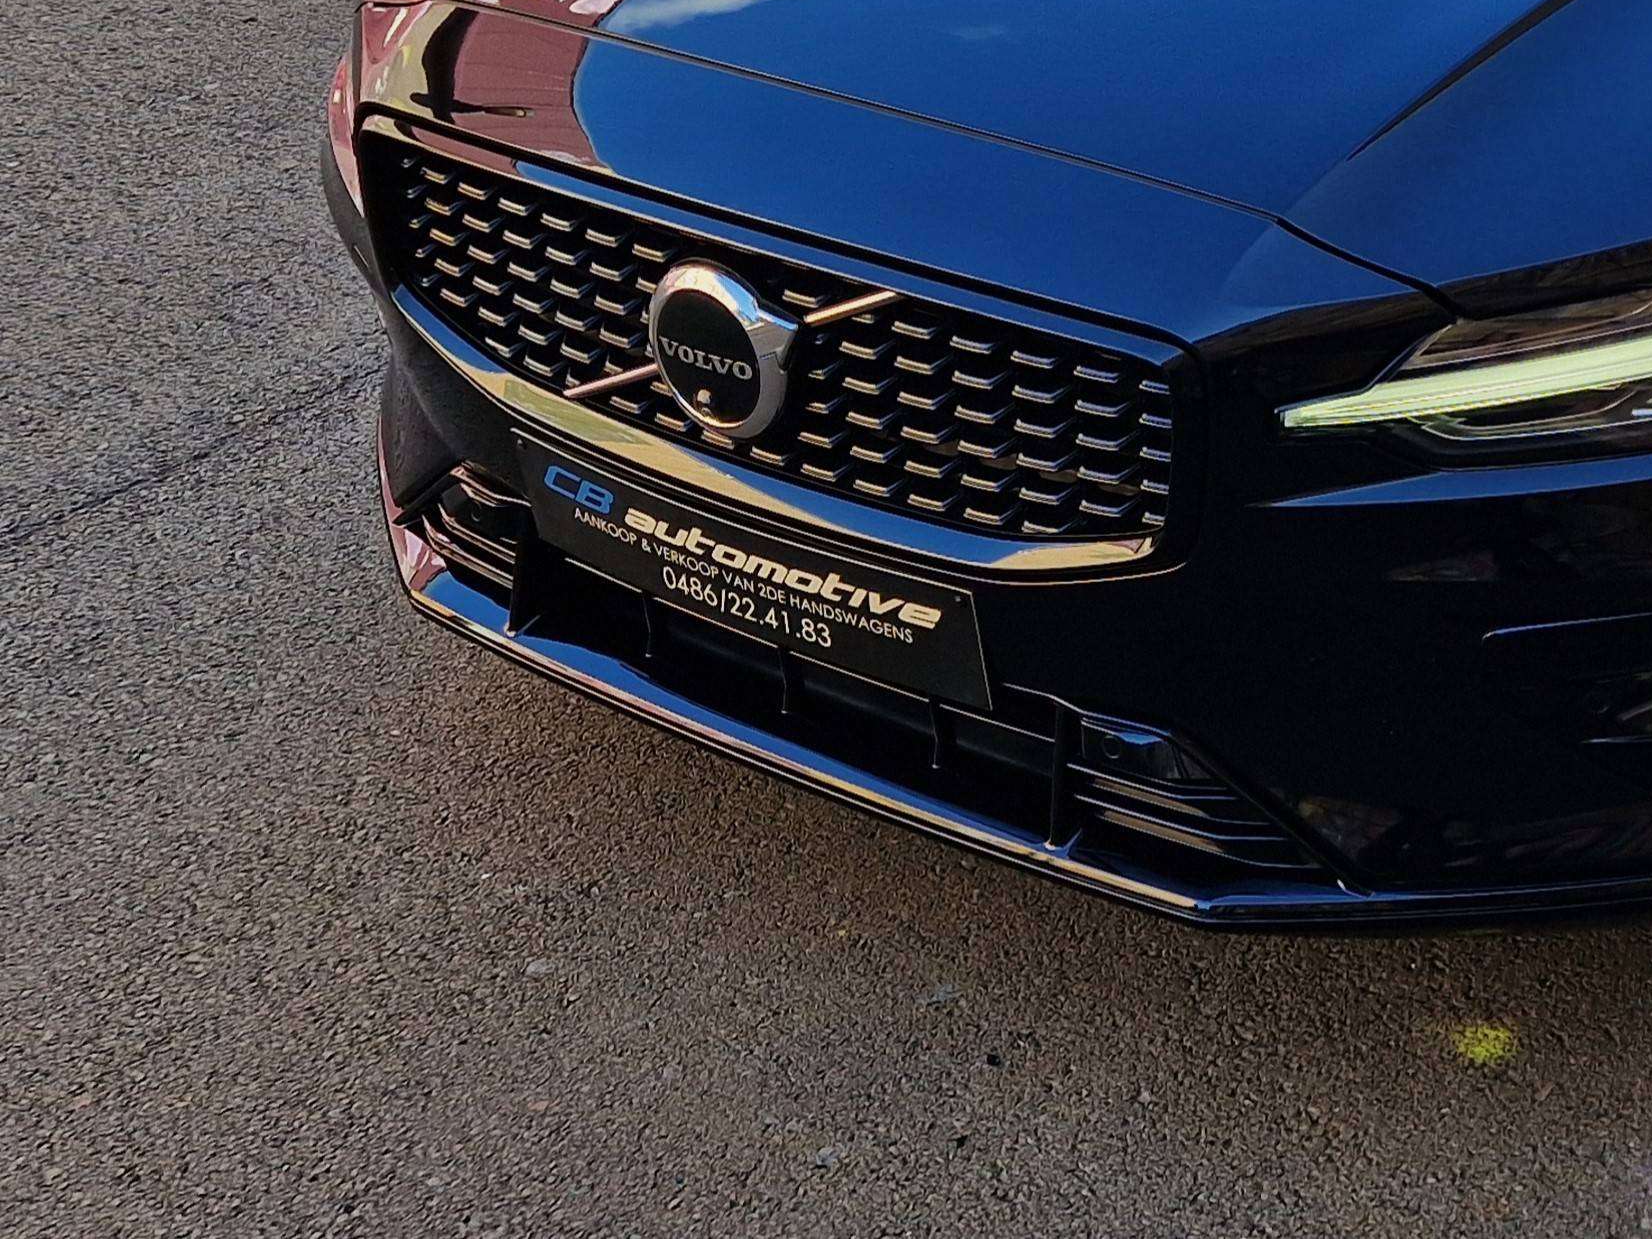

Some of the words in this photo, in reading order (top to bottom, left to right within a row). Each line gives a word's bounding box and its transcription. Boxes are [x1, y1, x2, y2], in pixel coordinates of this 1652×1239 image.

[658, 335, 753, 381] VOLVO
[544, 465, 614, 514] CB
[624, 507, 942, 630] automotive
[574, 507, 637, 546] AANKOOP
[641, 540, 651, 553] &
[653, 542, 719, 580] VERKOOP
[722, 570, 755, 594] VAN
[757, 583, 787, 604] 2DE
[789, 594, 914, 645] HANDSWAGENS
[662, 566, 832, 648] 0486/22.41.83
